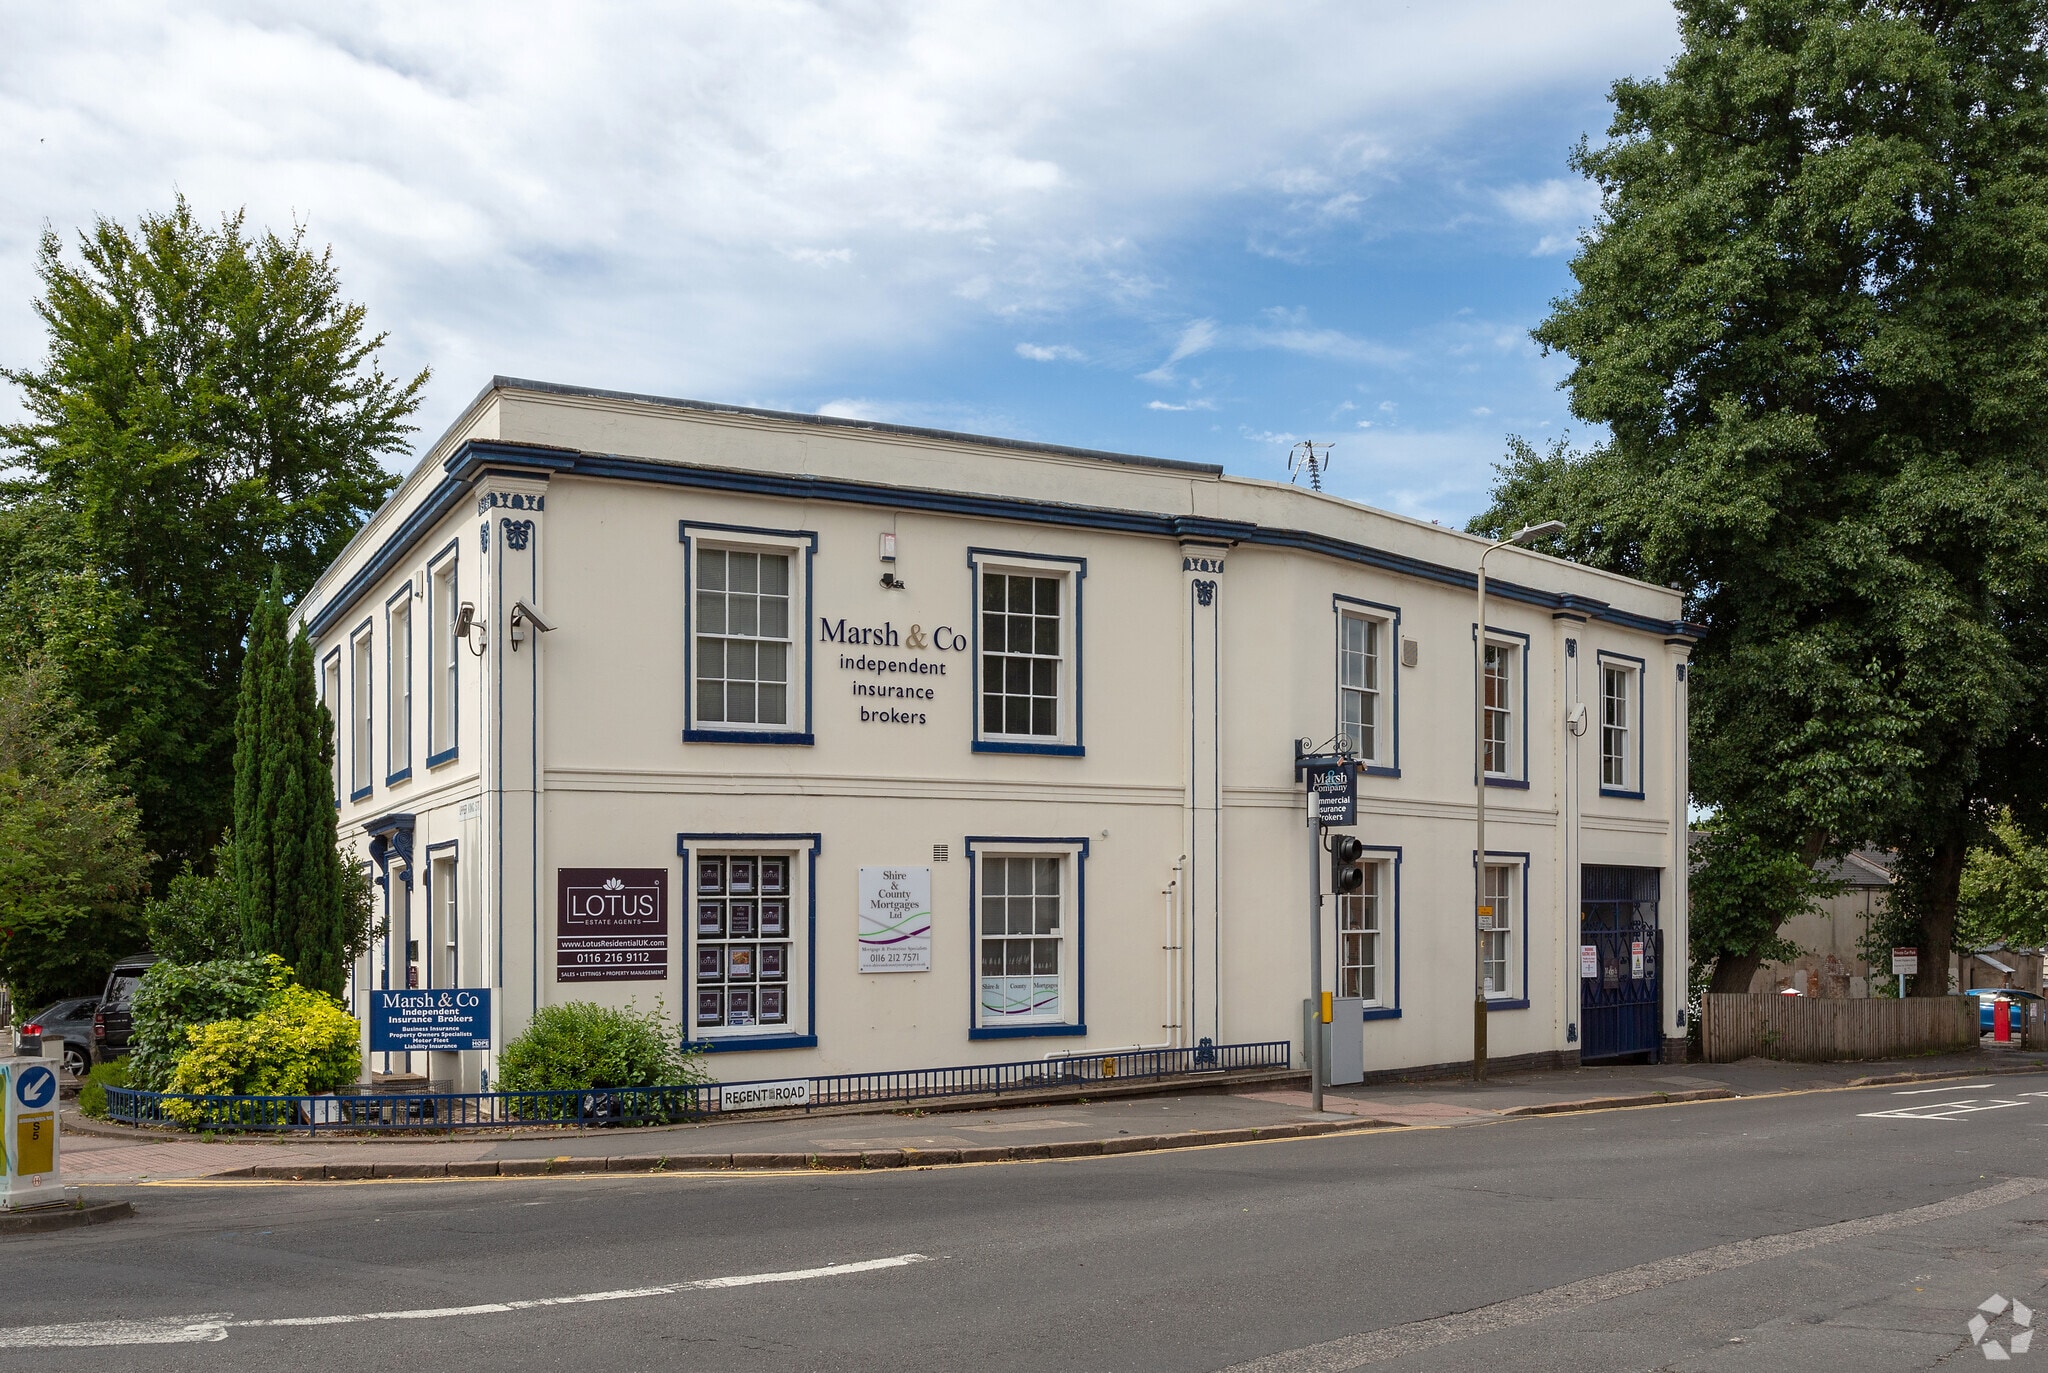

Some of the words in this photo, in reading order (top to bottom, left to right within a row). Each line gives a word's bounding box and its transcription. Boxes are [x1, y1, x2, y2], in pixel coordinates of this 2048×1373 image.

[819, 617, 900, 647] Marsh
[905, 623, 928, 650] &
[933, 626, 967, 651] Co
[840, 653, 947, 676] independent
[852, 680, 935, 700] insurance
[860, 705, 927, 725] brokers
[1314, 772, 1348, 784] Marsh
[1313, 784, 1347, 793] Company
[1319, 796, 1350, 804] mmercial
[1320, 805, 1347, 813] surance
[883, 870, 907, 880] Shire
[891, 881, 899, 890] &
[878, 889, 912, 900] County
[572, 894, 654, 916] LOTUS
[870, 900, 920, 912] Mortgages
[889, 911, 902, 919] Ltd
[561, 939, 665, 948] www.LotusResidentialUK.com
[577, 953, 601, 963] 0116
[604, 953, 623, 963] 216
[626, 952, 650, 962] 9112
[870, 954, 886, 962] 0116
[888, 953, 900, 962] 212
[903, 953, 919, 961] 7571
[382, 990, 435, 1008] Marsh
[437, 992, 453, 1007] &
[456, 991, 479, 1007] Co
[402, 1008, 460, 1017] Independent
[388, 1016, 433, 1024] Insurance
[437, 1015, 473, 1023] Brokers
[725, 1089, 768, 1104] REGENT
[775, 1086, 805, 1100] ROAD
[33, 1121, 40, 1131] S
[32, 1131, 39, 1140] 5
